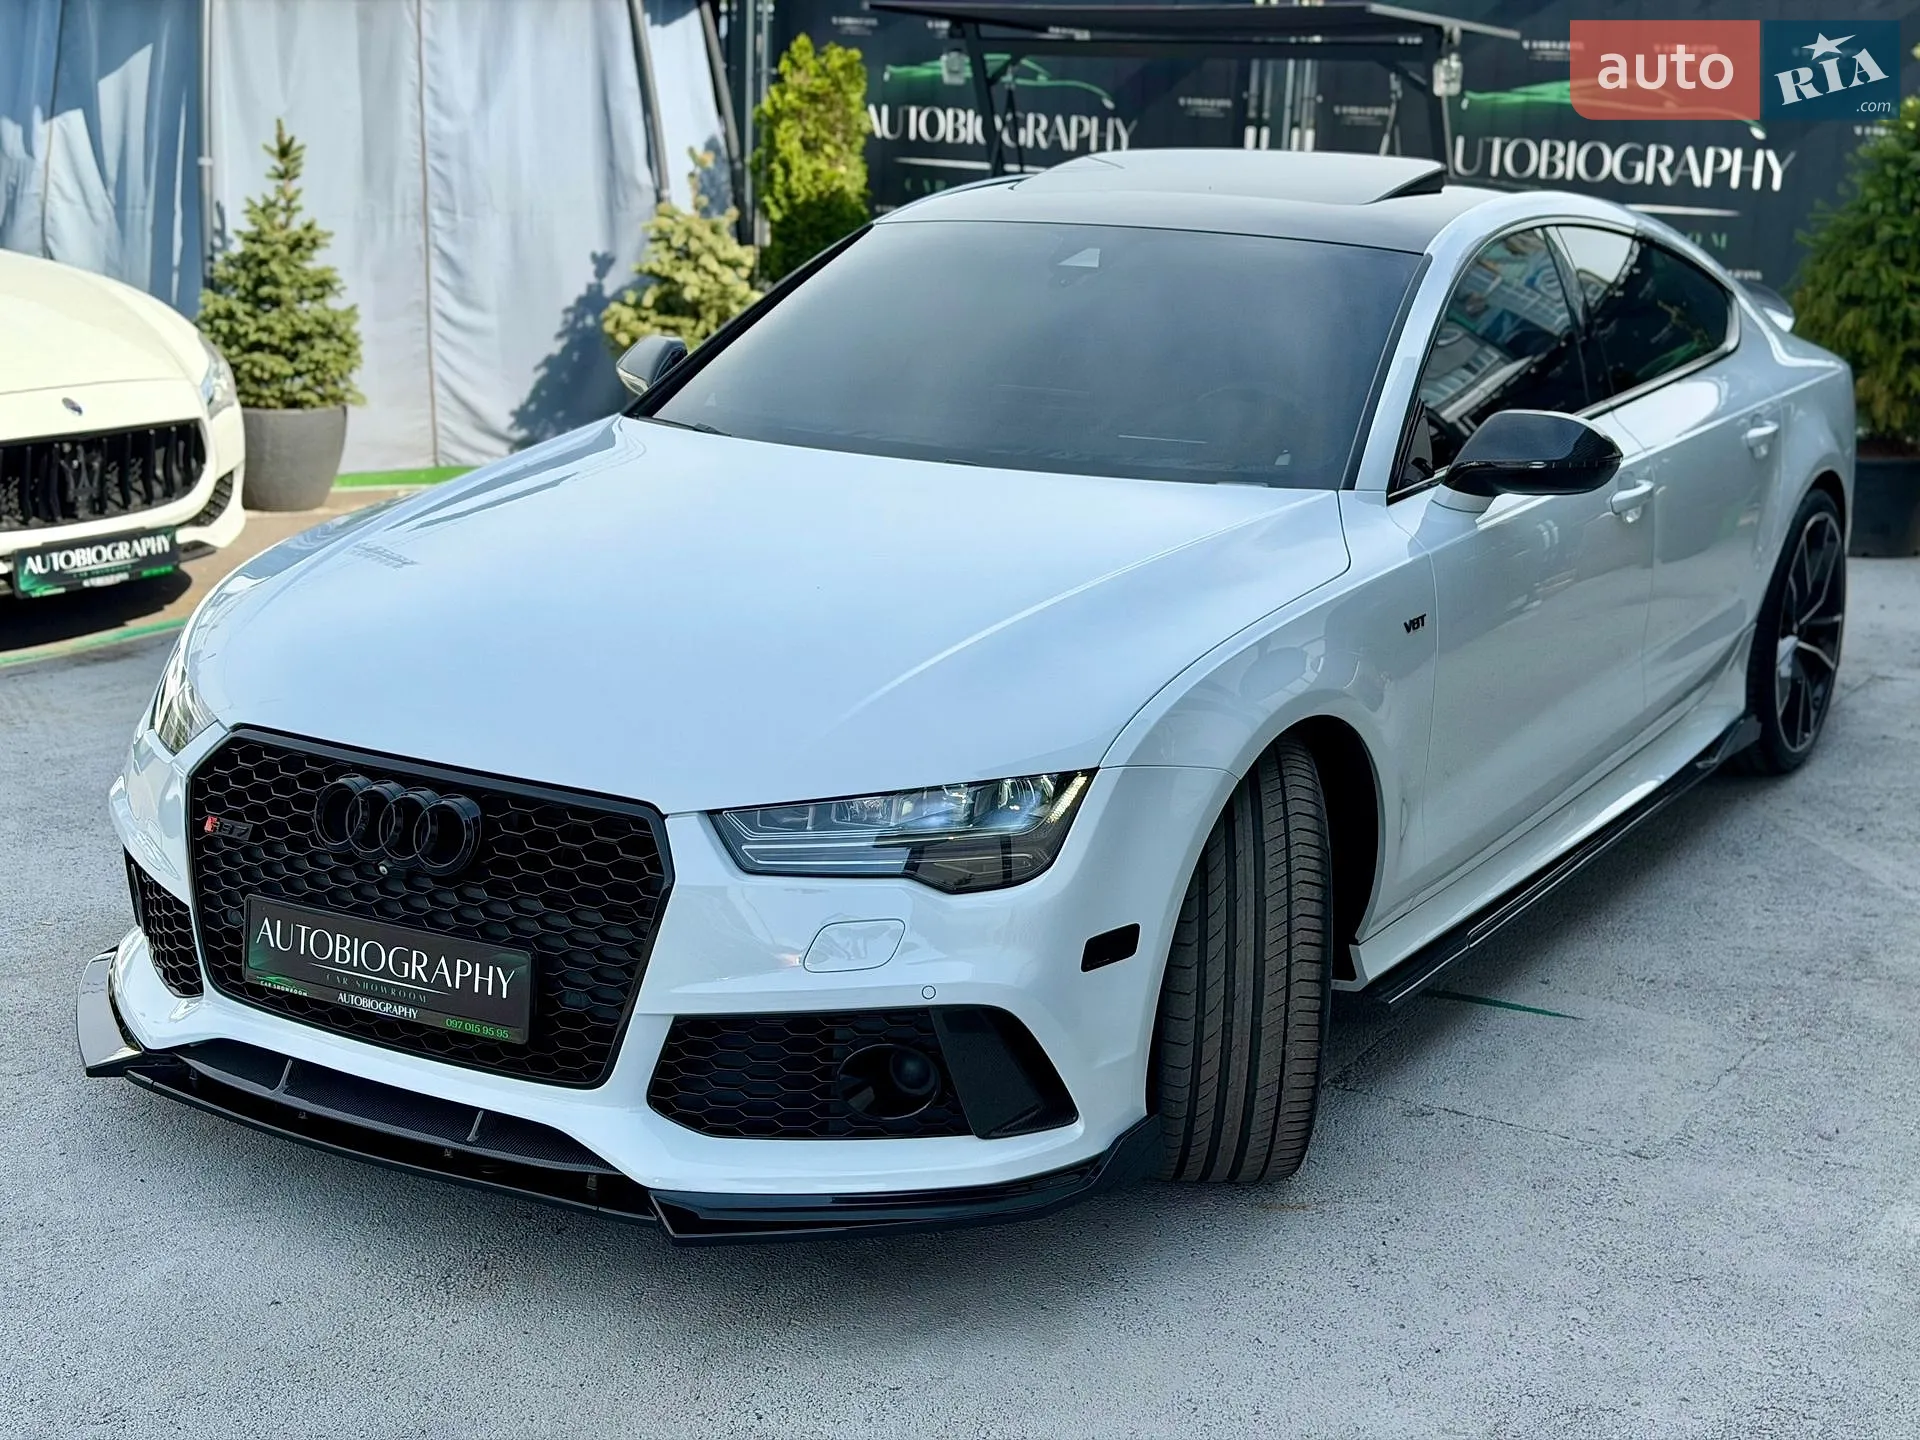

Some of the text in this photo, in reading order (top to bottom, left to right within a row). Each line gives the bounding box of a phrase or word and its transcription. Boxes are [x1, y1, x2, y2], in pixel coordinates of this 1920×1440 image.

[1454, 135, 1796, 192] UTOBIOGRAPHY
[24, 534, 172, 575] AUTOBIOGRAPHY
[1403, 613, 1427, 634] V8T
[255, 916, 516, 999] AUTOBIOGRAPHY
[337, 992, 418, 1019] AUTOBIOGRAPHY
[445, 1018, 509, 1039] 097 015 95 95
